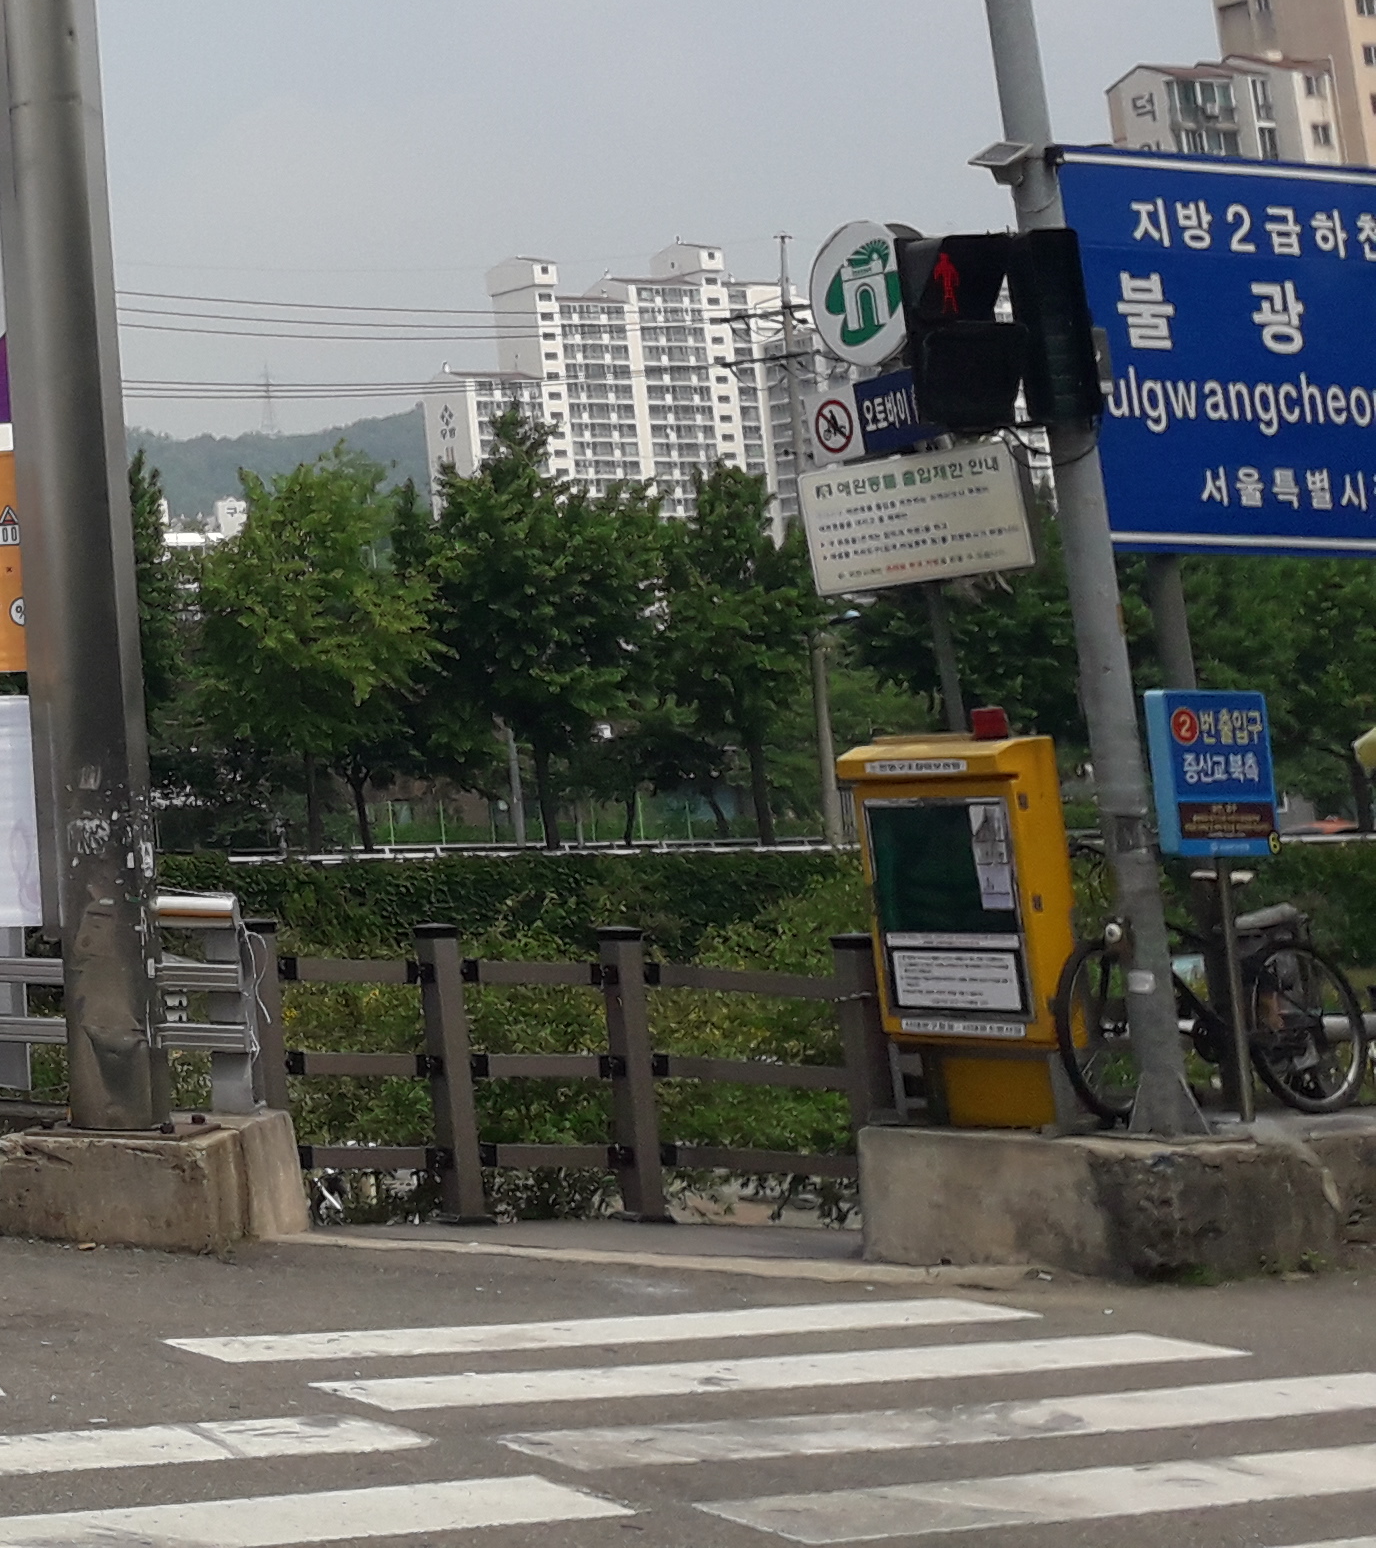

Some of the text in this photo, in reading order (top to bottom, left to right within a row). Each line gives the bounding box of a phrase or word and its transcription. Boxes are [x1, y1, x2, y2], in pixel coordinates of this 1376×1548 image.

[1107, 365, 1376, 436] ulgwangcheo
[968, 456, 999, 475] 안내
[1218, 708, 1262, 745] 출입구
[1183, 752, 1227, 784] 증산교
